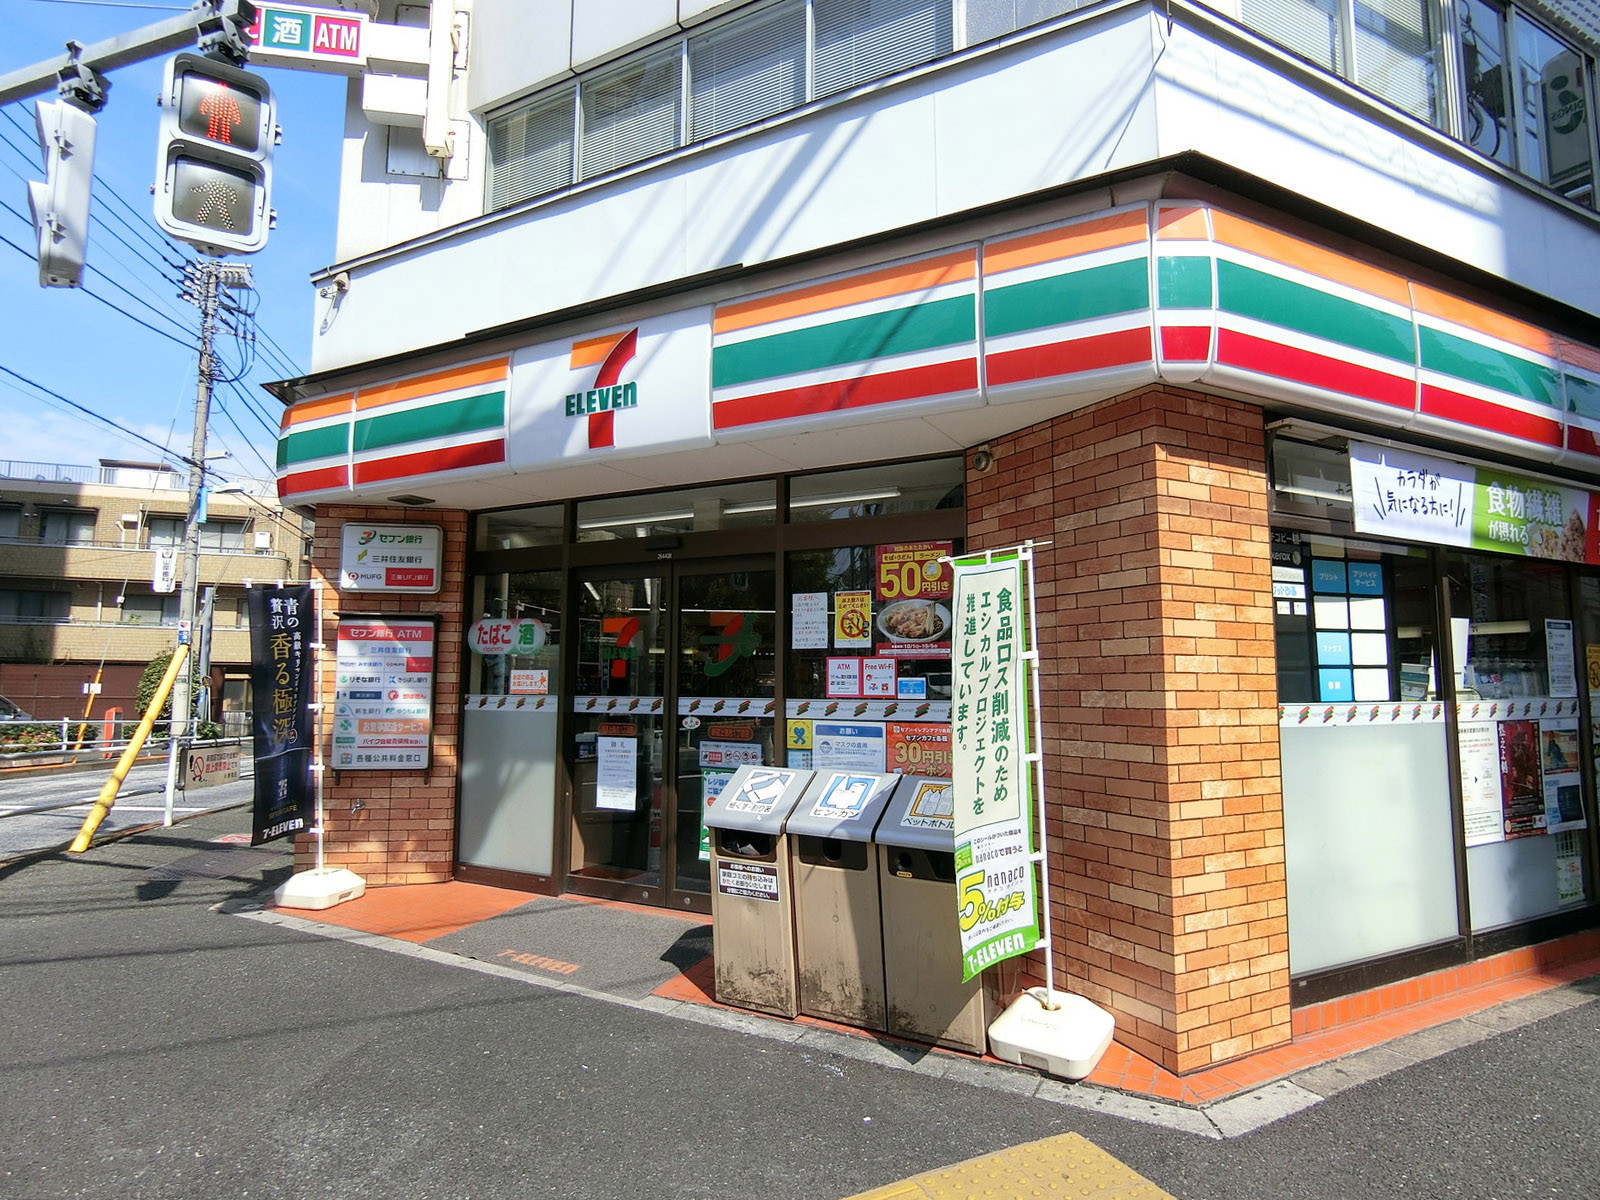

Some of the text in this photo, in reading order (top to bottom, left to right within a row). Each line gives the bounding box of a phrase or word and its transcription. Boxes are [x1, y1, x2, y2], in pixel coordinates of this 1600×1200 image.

[273, 16, 303, 45] 酒
[315, 21, 357, 52] ATM
[1397, 468, 1441, 491] カラダが
[1486, 480, 1563, 525] 食物繊維
[379, 534, 424, 545] セブン銀行
[1488, 519, 1529, 545] が摂れる
[372, 554, 423, 565] 三井住友銀行
[360, 573, 382, 581] MUFG
[270, 598, 285, 630] 贅沢
[284, 598, 299, 629] 青の
[350, 628, 422, 639] セブン銀行 ATM
[477, 624, 512, 645] たばこ
[518, 624, 535, 645] 酒
[837, 663, 850, 671] ATM
[865, 663, 877, 671] Free
[956, 593, 977, 751] 推進しています。
[269, 632, 293, 744] 香る極深
[990, 587, 1013, 802] 食品ロス削減のため
[972, 591, 992, 816] エシカルプロジェクトを
[839, 727, 858, 735] お願い
[907, 764, 948, 777] クーポン
[902, 818, 955, 829] ペットボトル
[975, 845, 1024, 864] nanacoで買うと
[987, 865, 1025, 888] nanaco
